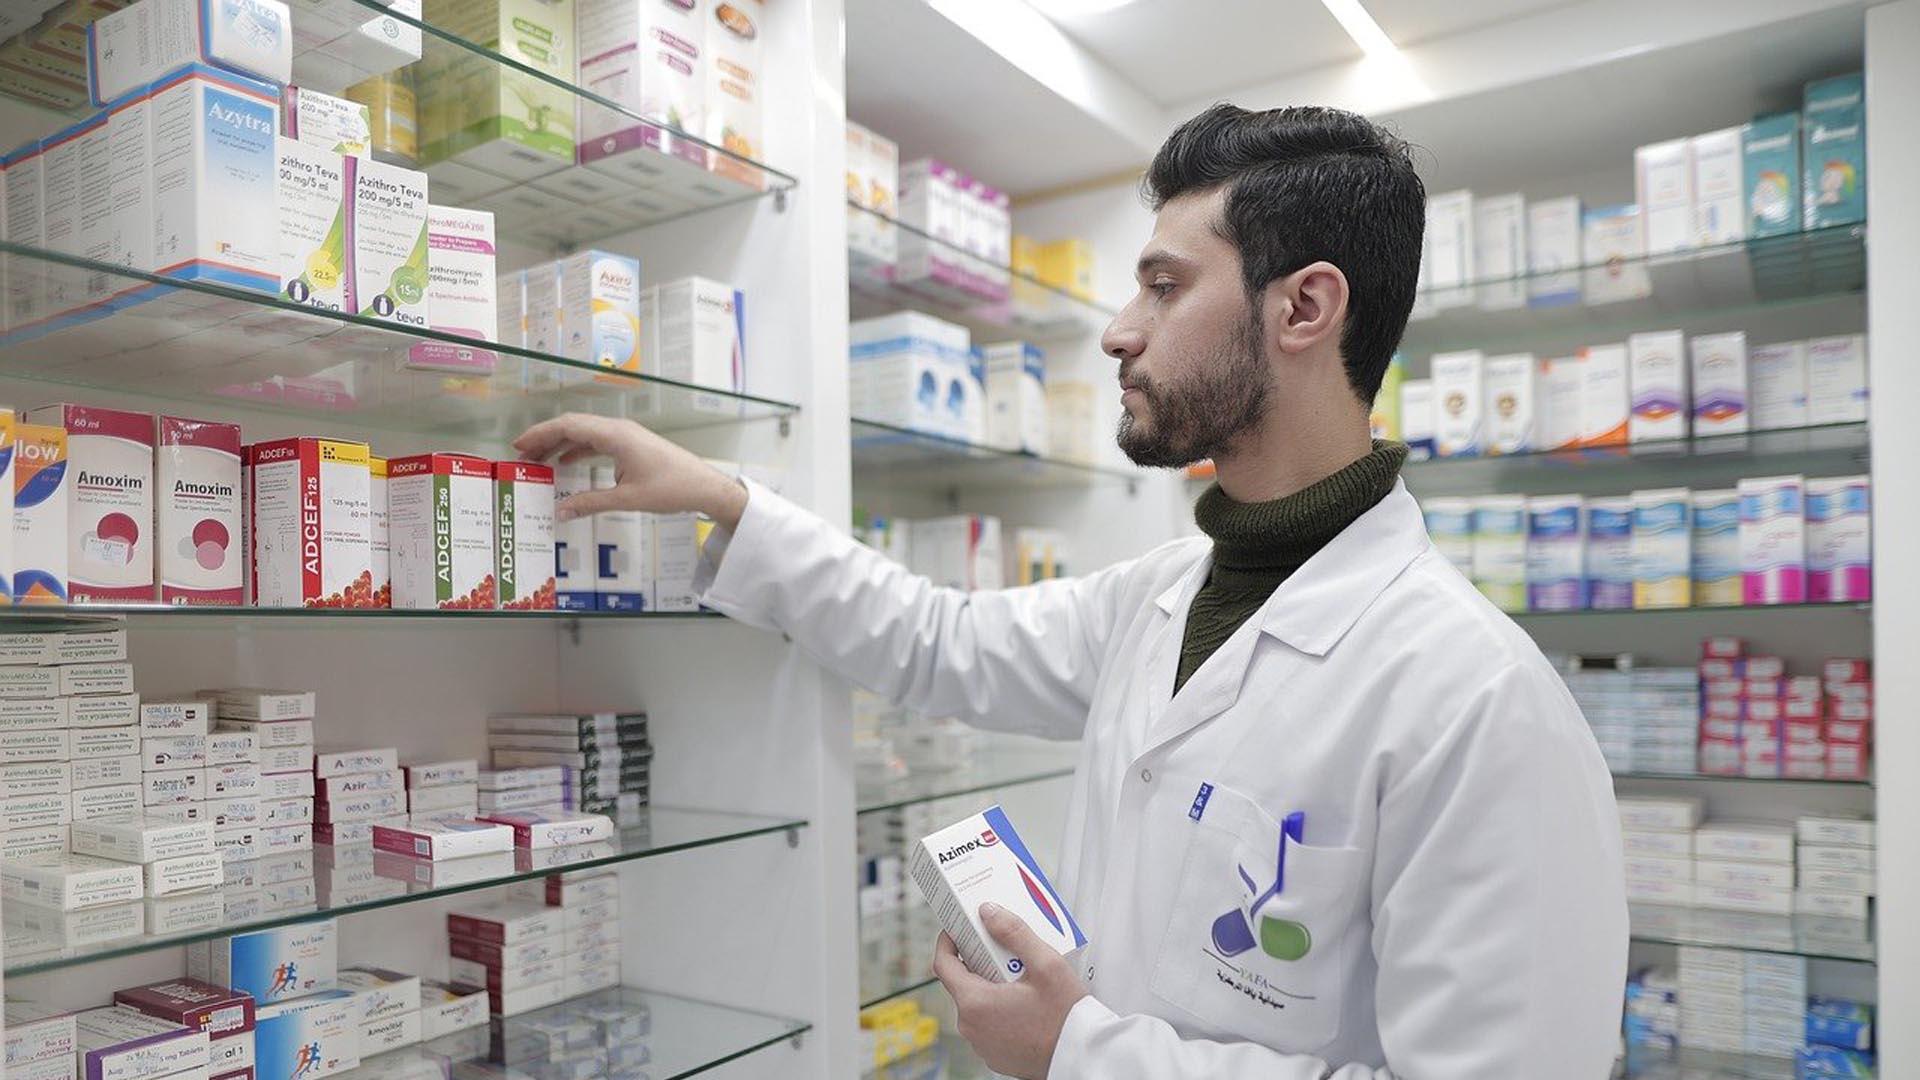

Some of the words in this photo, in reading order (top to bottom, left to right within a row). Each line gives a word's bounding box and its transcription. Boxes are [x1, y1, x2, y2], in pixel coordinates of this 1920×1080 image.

[208, 101, 271, 135] Azytra
[280, 168, 292, 180] 00
[281, 155, 313, 173] zithro
[315, 164, 339, 181] Teva
[358, 176, 397, 193] Azithro
[400, 184, 424, 200] Teva
[358, 189, 377, 202] 200
[430, 266, 482, 278] zithromycin
[395, 310, 424, 325] teva
[77, 471, 142, 489] Amoxim
[174, 480, 232, 496] Amoxim
[938, 837, 983, 865] Azimex
[1240, 967, 1269, 990] YAFA
